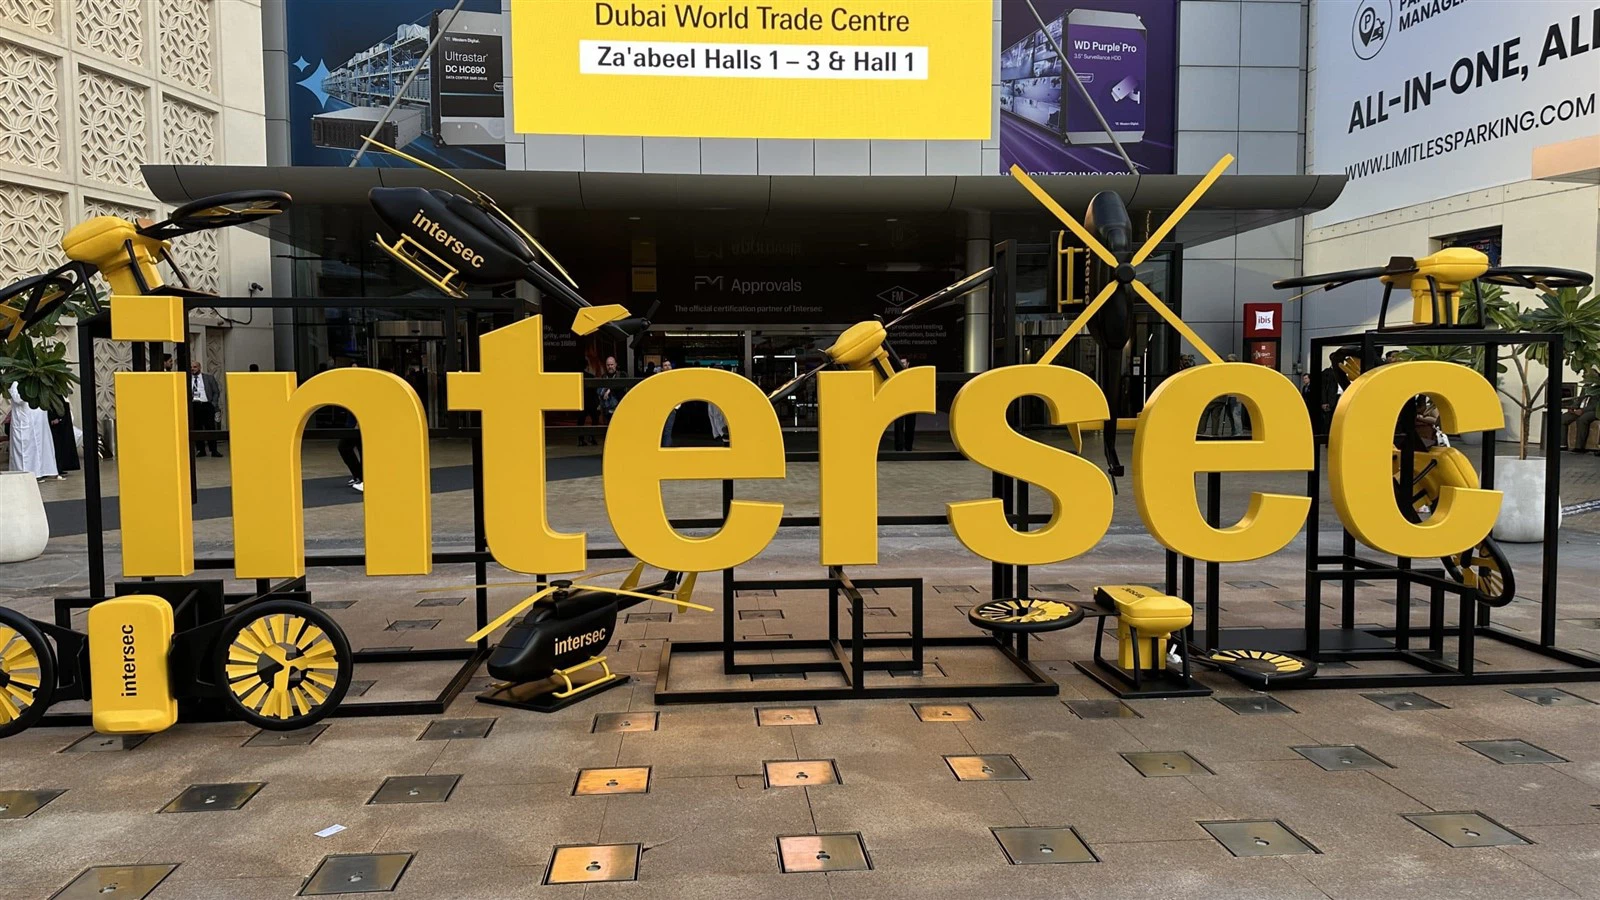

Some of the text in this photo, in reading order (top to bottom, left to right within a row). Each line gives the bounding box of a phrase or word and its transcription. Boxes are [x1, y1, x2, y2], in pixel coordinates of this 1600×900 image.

[595, 2, 910, 32] Dubai World Trade Centre
[1399, 0, 1467, 32] MANAG
[597, 45, 696, 69] Za'abeel
[705, 48, 762, 70] Halls
[769, 50, 778, 70] 1
[806, 50, 820, 71] 3
[829, 51, 845, 71] &
[854, 51, 897, 72] Hall
[904, 52, 914, 72] 1
[1074, 40, 1090, 50] WD
[1122, 43, 1137, 53] Pro
[445, 65, 486, 74] DC HC690
[1348, 37, 1529, 134] ALL-IN-ONE,
[1345, 93, 1595, 182] WWW.LIMITLESSPARKING.COM
[411, 208, 485, 268] intersec
[731, 277, 802, 295] Approvals
[891, 291, 904, 302] FM
[674, 304, 824, 314] The official certification partner of Intersec
[1258, 316, 1271, 324] ibis
[110, 295, 1505, 579] intersec
[554, 628, 606, 656] intersec
[121, 624, 137, 696] intersec
